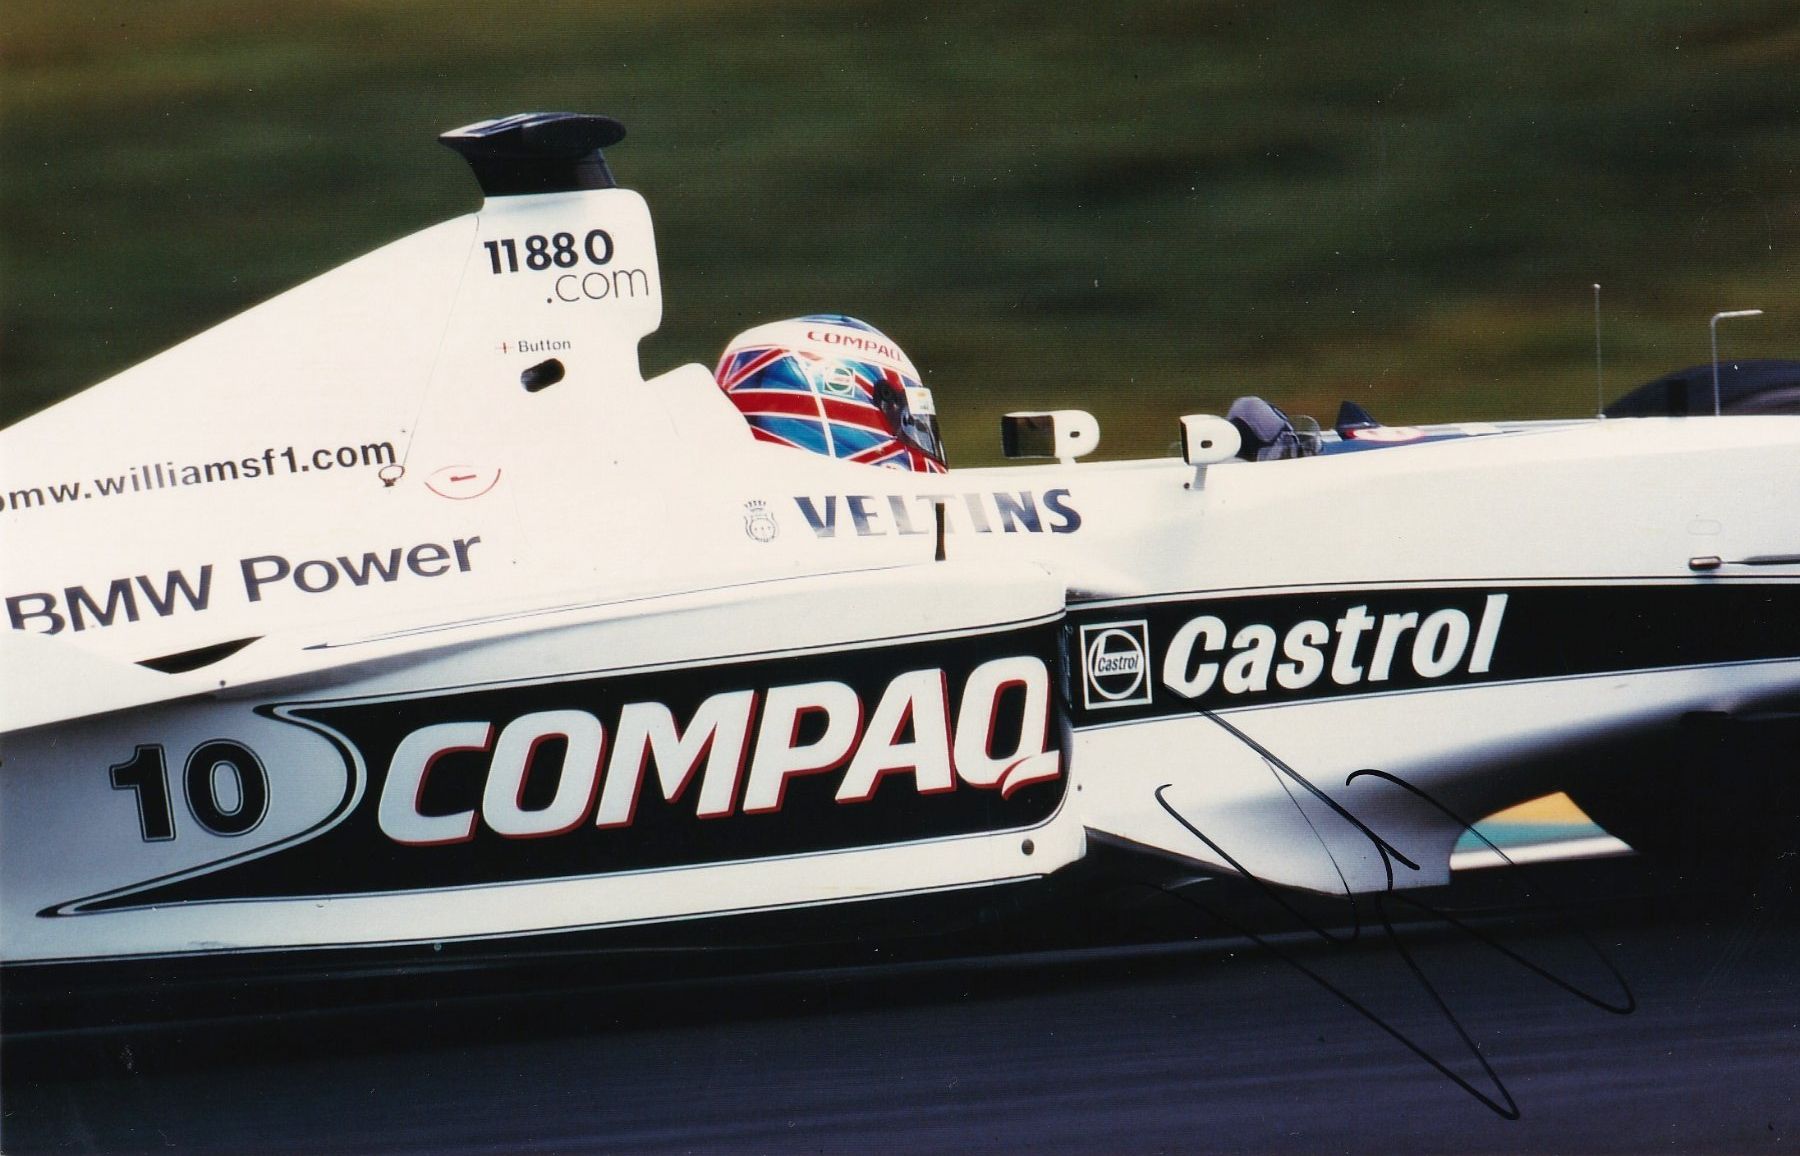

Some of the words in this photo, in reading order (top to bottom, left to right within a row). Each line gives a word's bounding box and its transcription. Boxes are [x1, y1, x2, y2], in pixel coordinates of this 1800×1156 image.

[484, 229, 614, 275] 11880
[547, 269, 649, 304] .com
[518, 340, 571, 354] Button
[793, 488, 1082, 538] VELTINS
[5, 564, 213, 636] BMW
[240, 535, 482, 603] Power
[1097, 654, 1139, 672] Castrol
[1163, 593, 1509, 699] Castrol
[378, 655, 1060, 846] COMPAQ
[109, 737, 271, 843] 10
